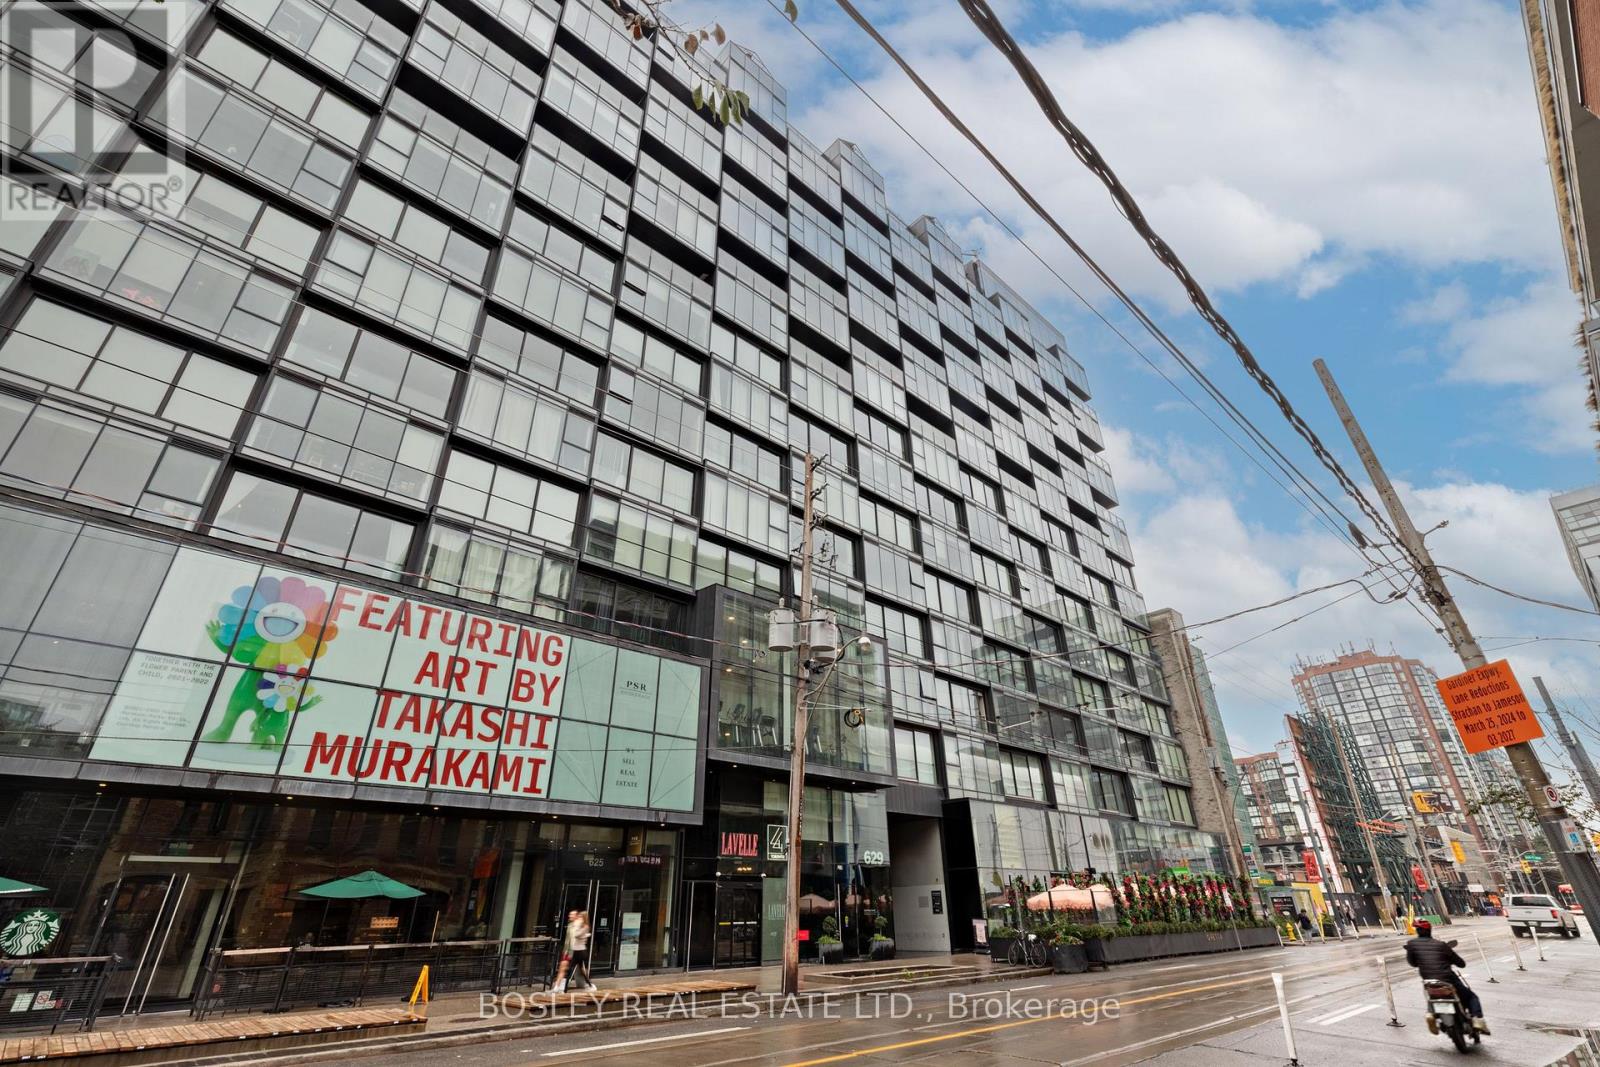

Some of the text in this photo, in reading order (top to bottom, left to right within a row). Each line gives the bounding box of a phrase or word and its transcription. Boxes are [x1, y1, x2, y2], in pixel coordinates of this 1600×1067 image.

[332, 585, 564, 667] FEATURING
[413, 651, 561, 707] ART BY
[626, 680, 647, 692] PSR
[1446, 673, 1476, 690] Gardiner
[1451, 680, 1510, 704] Lane Reductions
[1451, 693, 1527, 721] Strachan to Jameson
[375, 689, 553, 750] TAKASHI
[1464, 720, 1486, 734] March
[1498, 712, 1516, 726] 2024
[1516, 710, 1527, 721] to
[1487, 729, 1516, 746] Q3 2027
[303, 731, 547, 795] MURAKAMI
[721, 832, 759, 857] LAVELLE
[863, 850, 883, 865] 629
